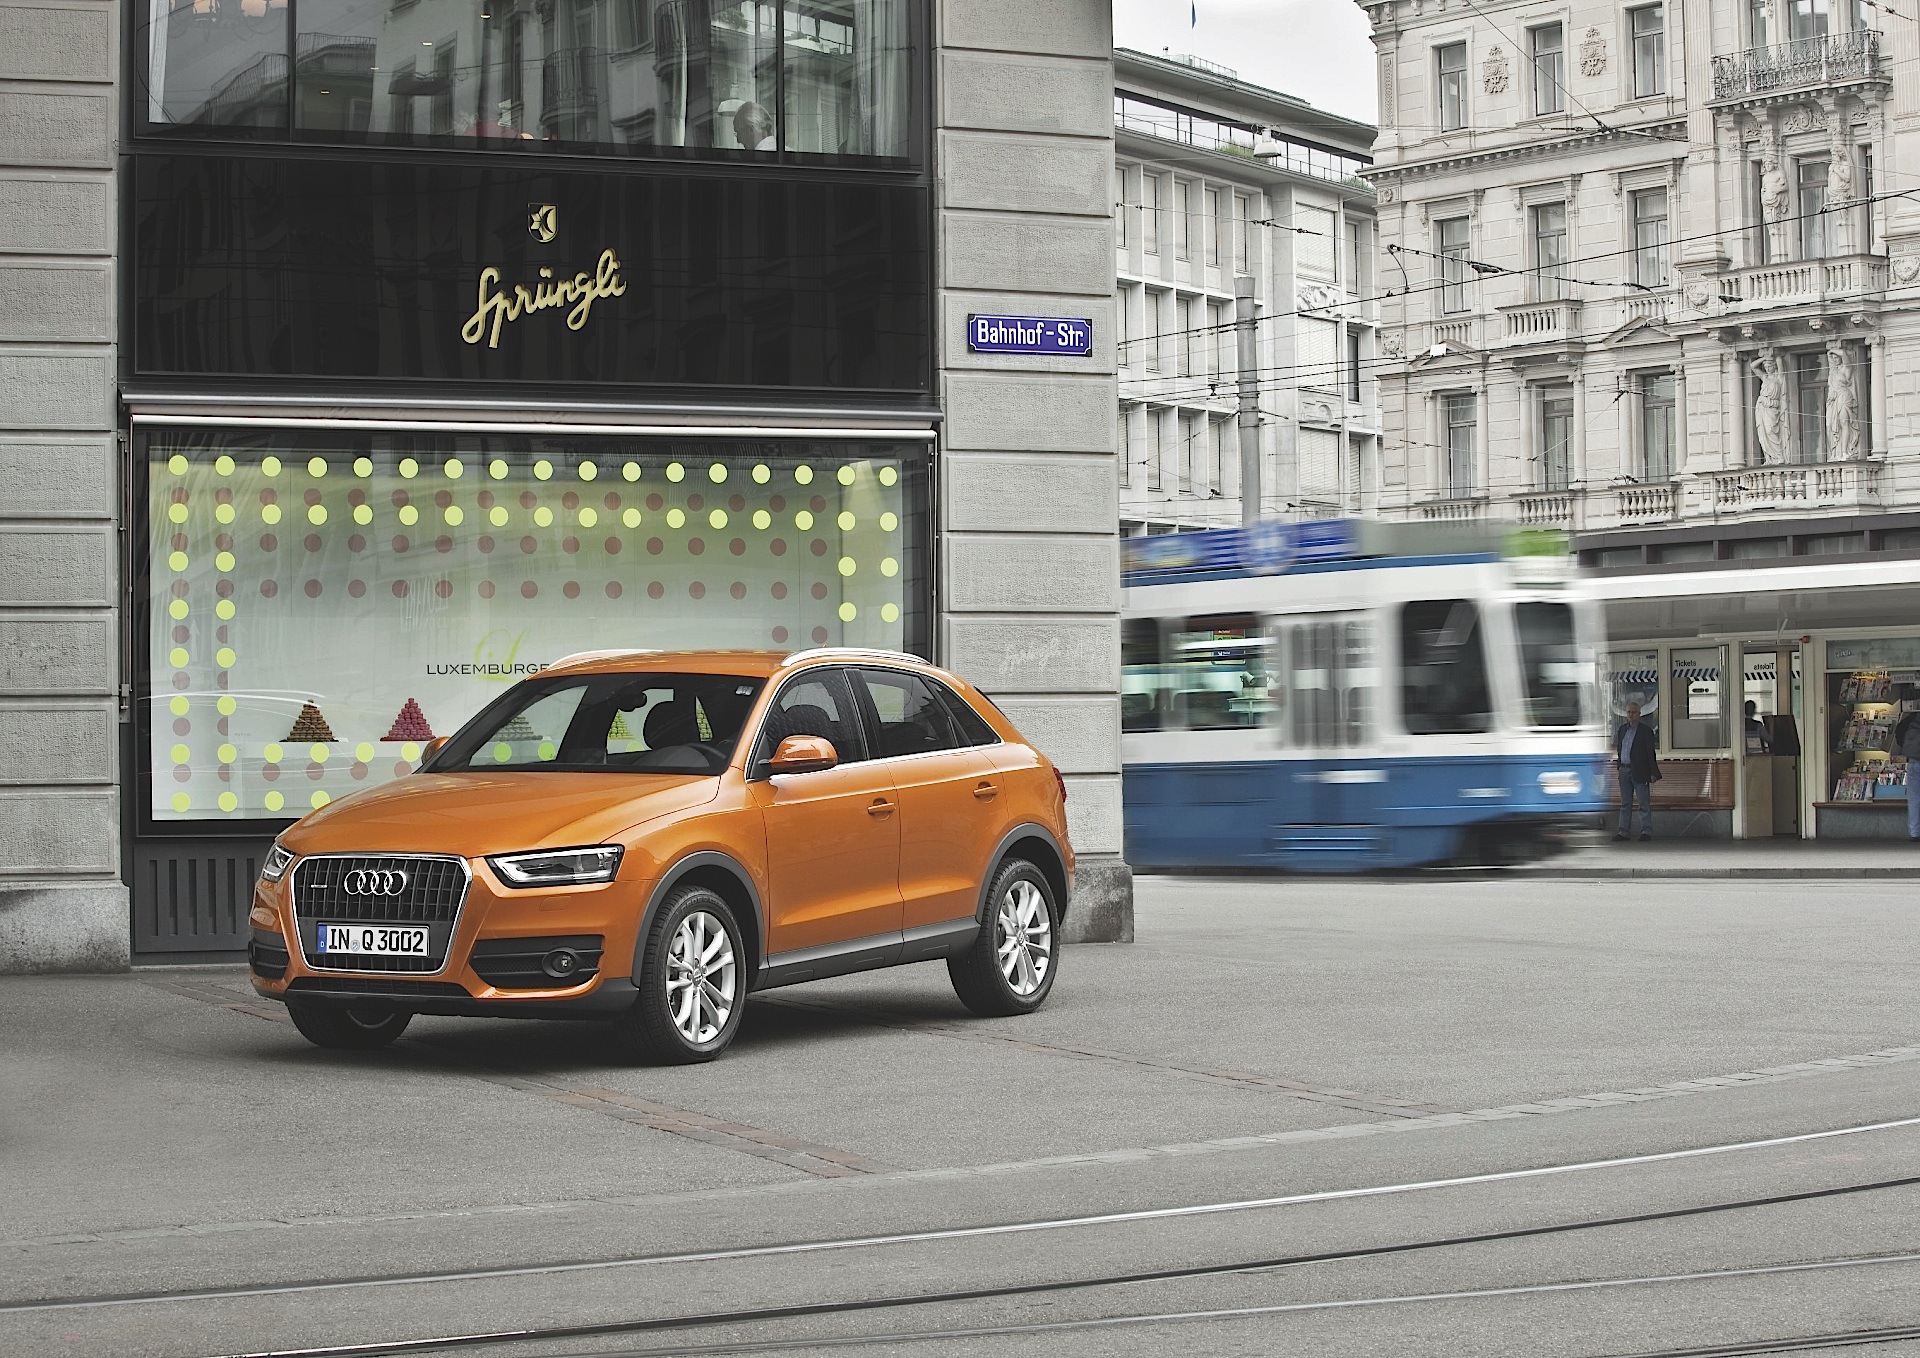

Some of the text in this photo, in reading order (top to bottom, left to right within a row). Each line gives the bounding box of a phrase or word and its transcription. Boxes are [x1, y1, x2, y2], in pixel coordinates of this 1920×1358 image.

[461, 248, 627, 348] Sprüngli
[328, 928, 424, 953] IN Q 3002
